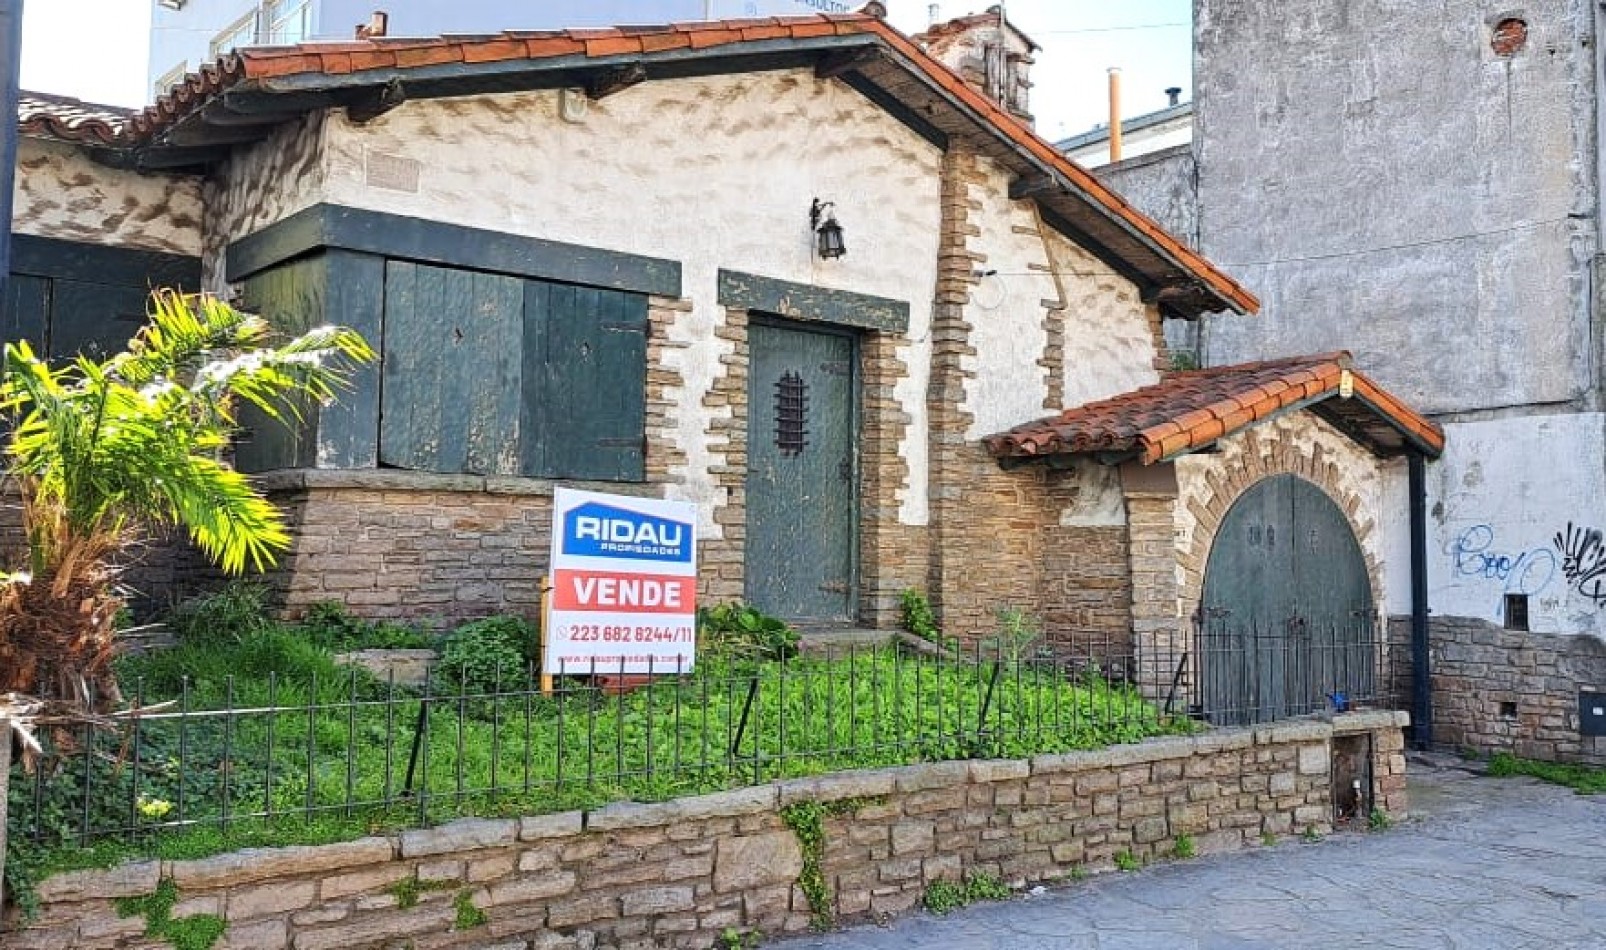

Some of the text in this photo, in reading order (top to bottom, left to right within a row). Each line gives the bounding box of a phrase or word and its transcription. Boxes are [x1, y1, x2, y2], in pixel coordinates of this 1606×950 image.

[575, 516, 681, 546] RIDAU
[573, 577, 681, 608] VENDE
[570, 625, 599, 641] 223
